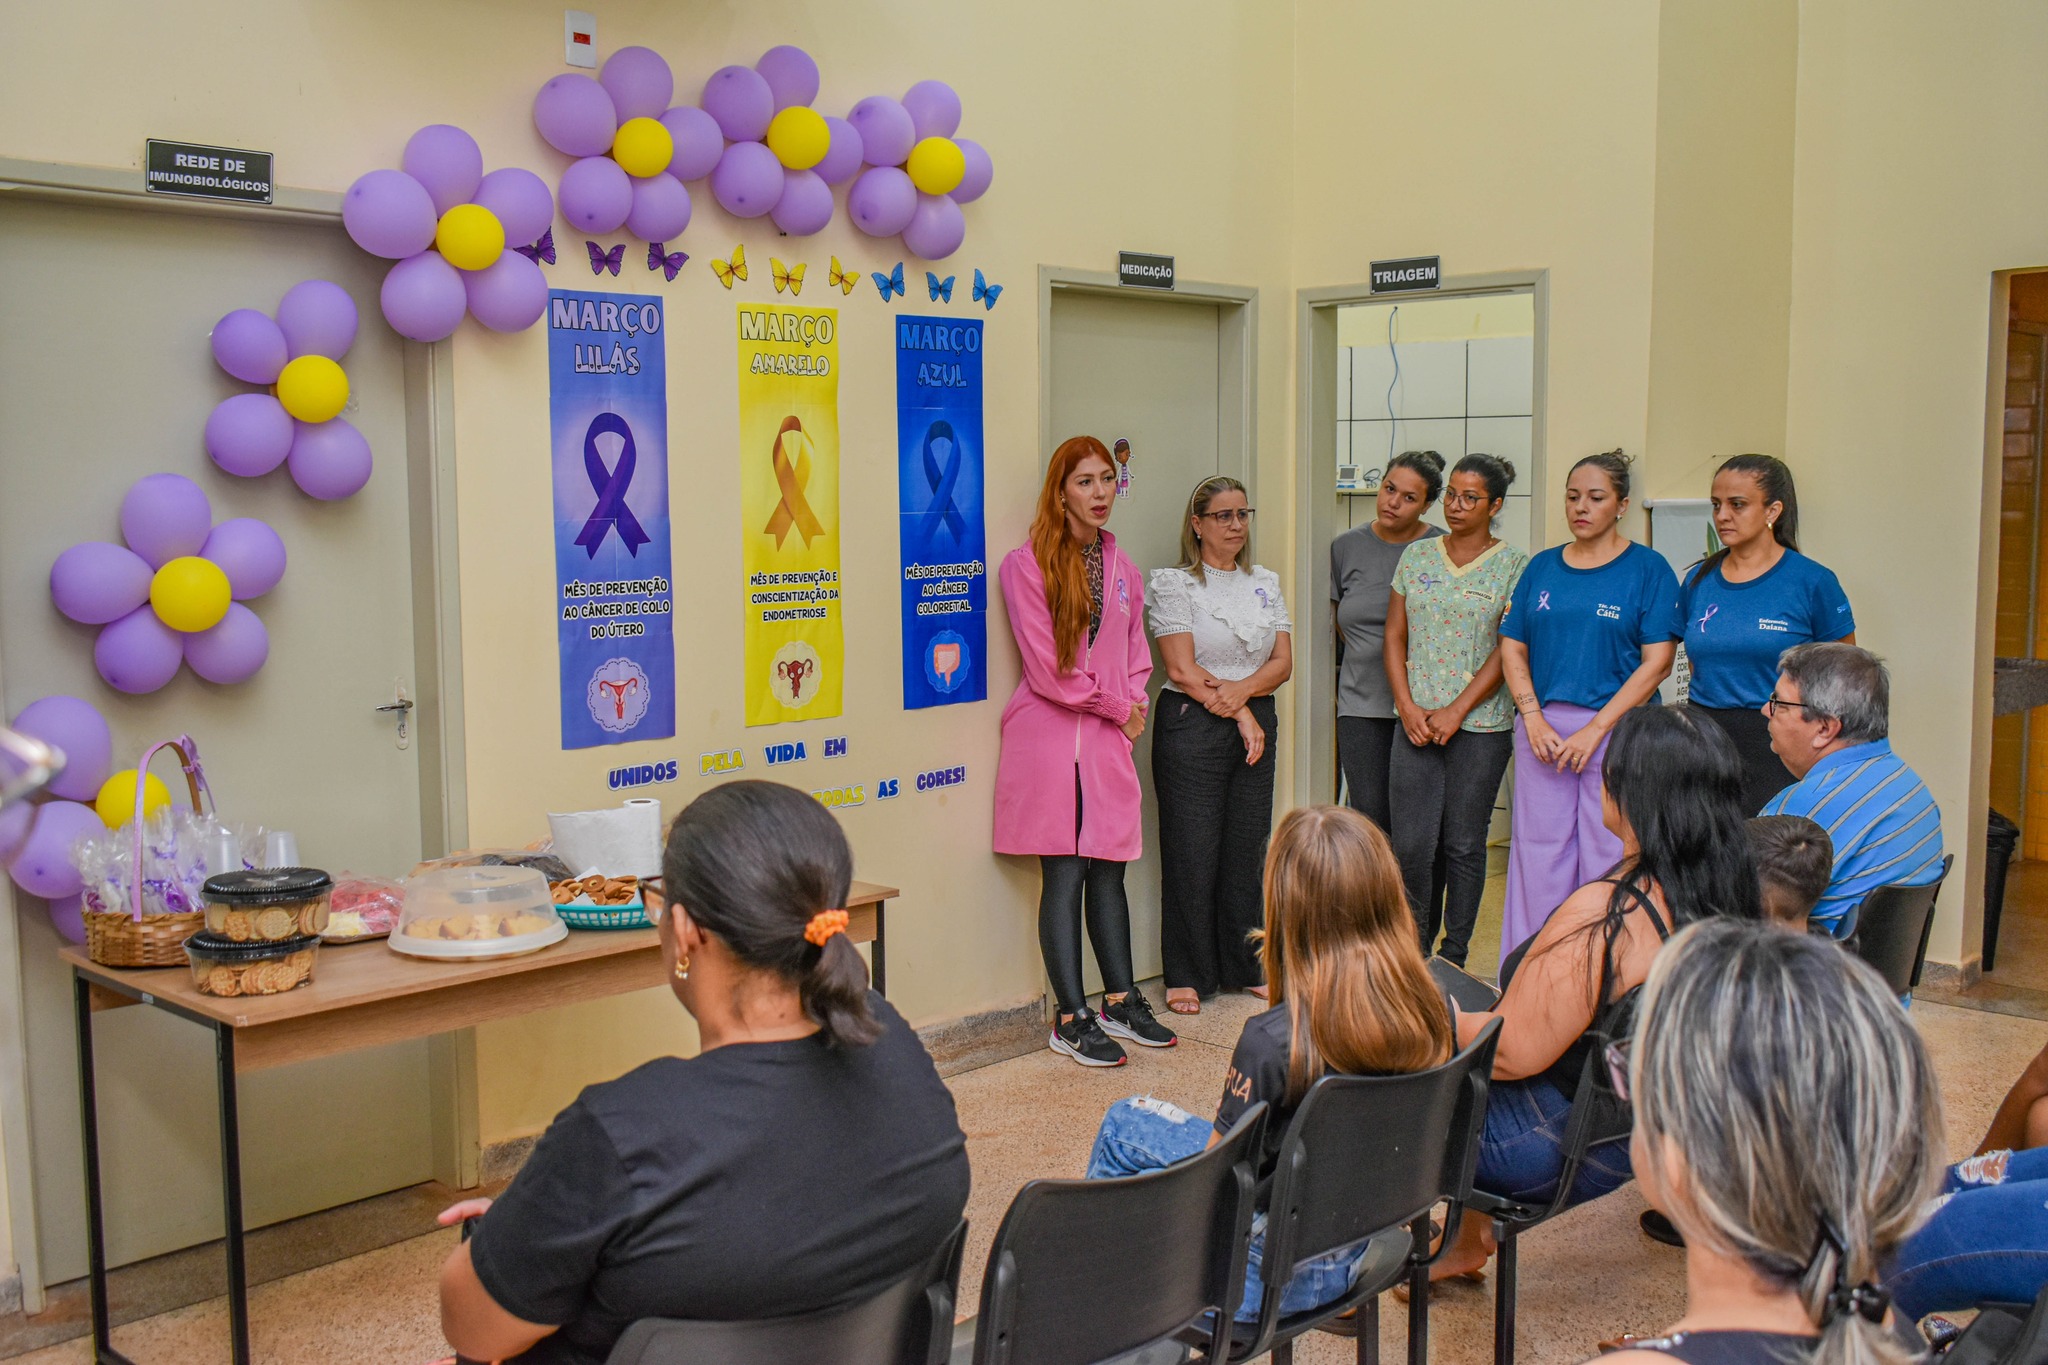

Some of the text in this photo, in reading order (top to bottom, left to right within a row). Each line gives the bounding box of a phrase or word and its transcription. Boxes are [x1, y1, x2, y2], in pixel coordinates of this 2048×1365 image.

[175, 153, 246, 173] REDE DE
[149, 171, 270, 193] IMUNOBIOLÓGICOS
[1121, 263, 1172, 279] MEDICAÇÃO
[1373, 266, 1437, 284] TRIAGEM
[551, 297, 661, 338] MARÇO
[740, 311, 834, 348] MARÇO
[900, 323, 981, 356] MARÇO
[575, 341, 641, 376] LILÁS
[750, 352, 830, 377] AMARELO
[916, 362, 968, 388] AZUL
[750, 569, 837, 586] MÊS DE PREVENÇÃO E
[906, 561, 983, 578] MÊS DE PREVENÇÃO
[565, 577, 668, 597] MÊS DE PREVENÇÃO
[751, 587, 839, 604] CONSCIENTIZAÇÃO DA
[923, 581, 968, 595] AO CÂNCER
[563, 600, 670, 619] AO CÂNCER DE COLO
[763, 607, 827, 621] ENDOMETRIOSE
[917, 600, 971, 614] COLORRETAL
[1596, 608, 1620, 620] Cátia
[591, 621, 644, 638] DO ÚTERO
[1758, 618, 1789, 626] Enfermeira
[1758, 623, 1788, 632] Daiana
[609, 737, 847, 788] UNIDOS PELA VIDA EM
[812, 766, 966, 808] TODAS AS CORES!
